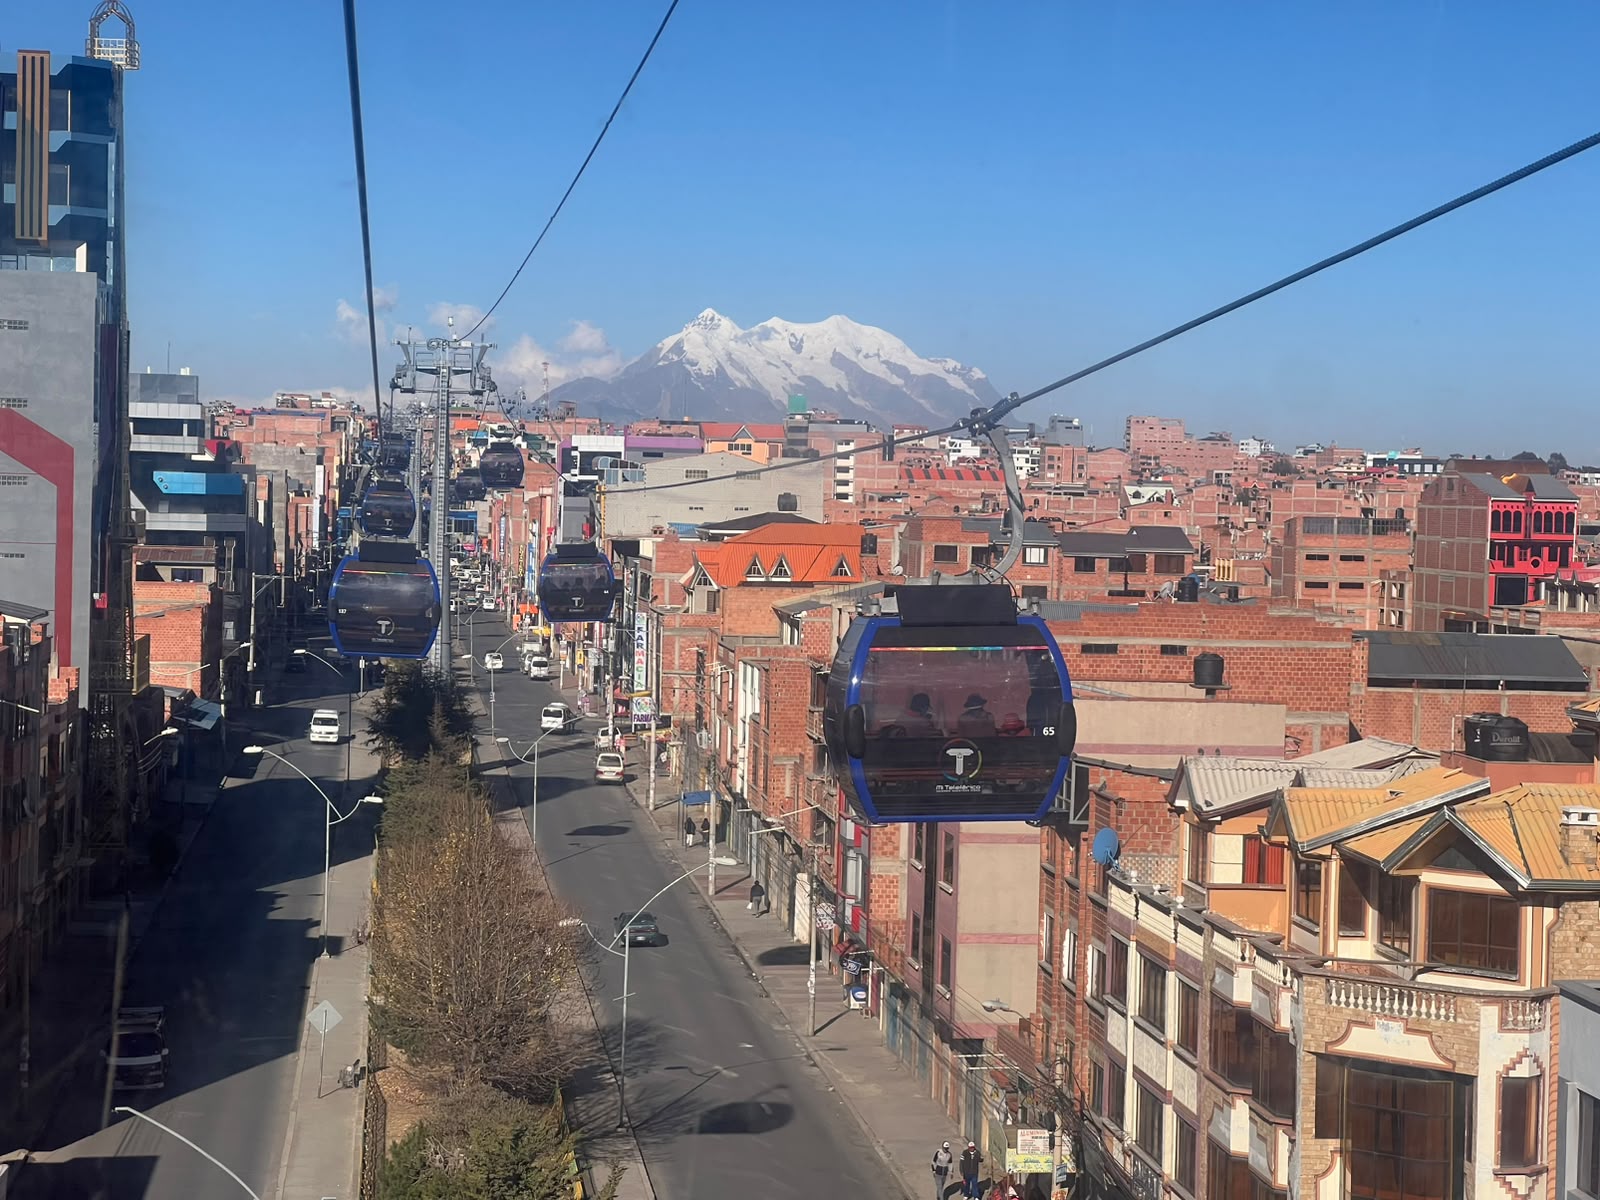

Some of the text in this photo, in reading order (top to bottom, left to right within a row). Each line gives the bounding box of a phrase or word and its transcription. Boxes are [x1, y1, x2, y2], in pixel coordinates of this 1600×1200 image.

[376, 620, 391, 634] T
[635, 626, 645, 688] FARMACIA
[1042, 726, 1055, 735] 65
[946, 748, 974, 775] T
